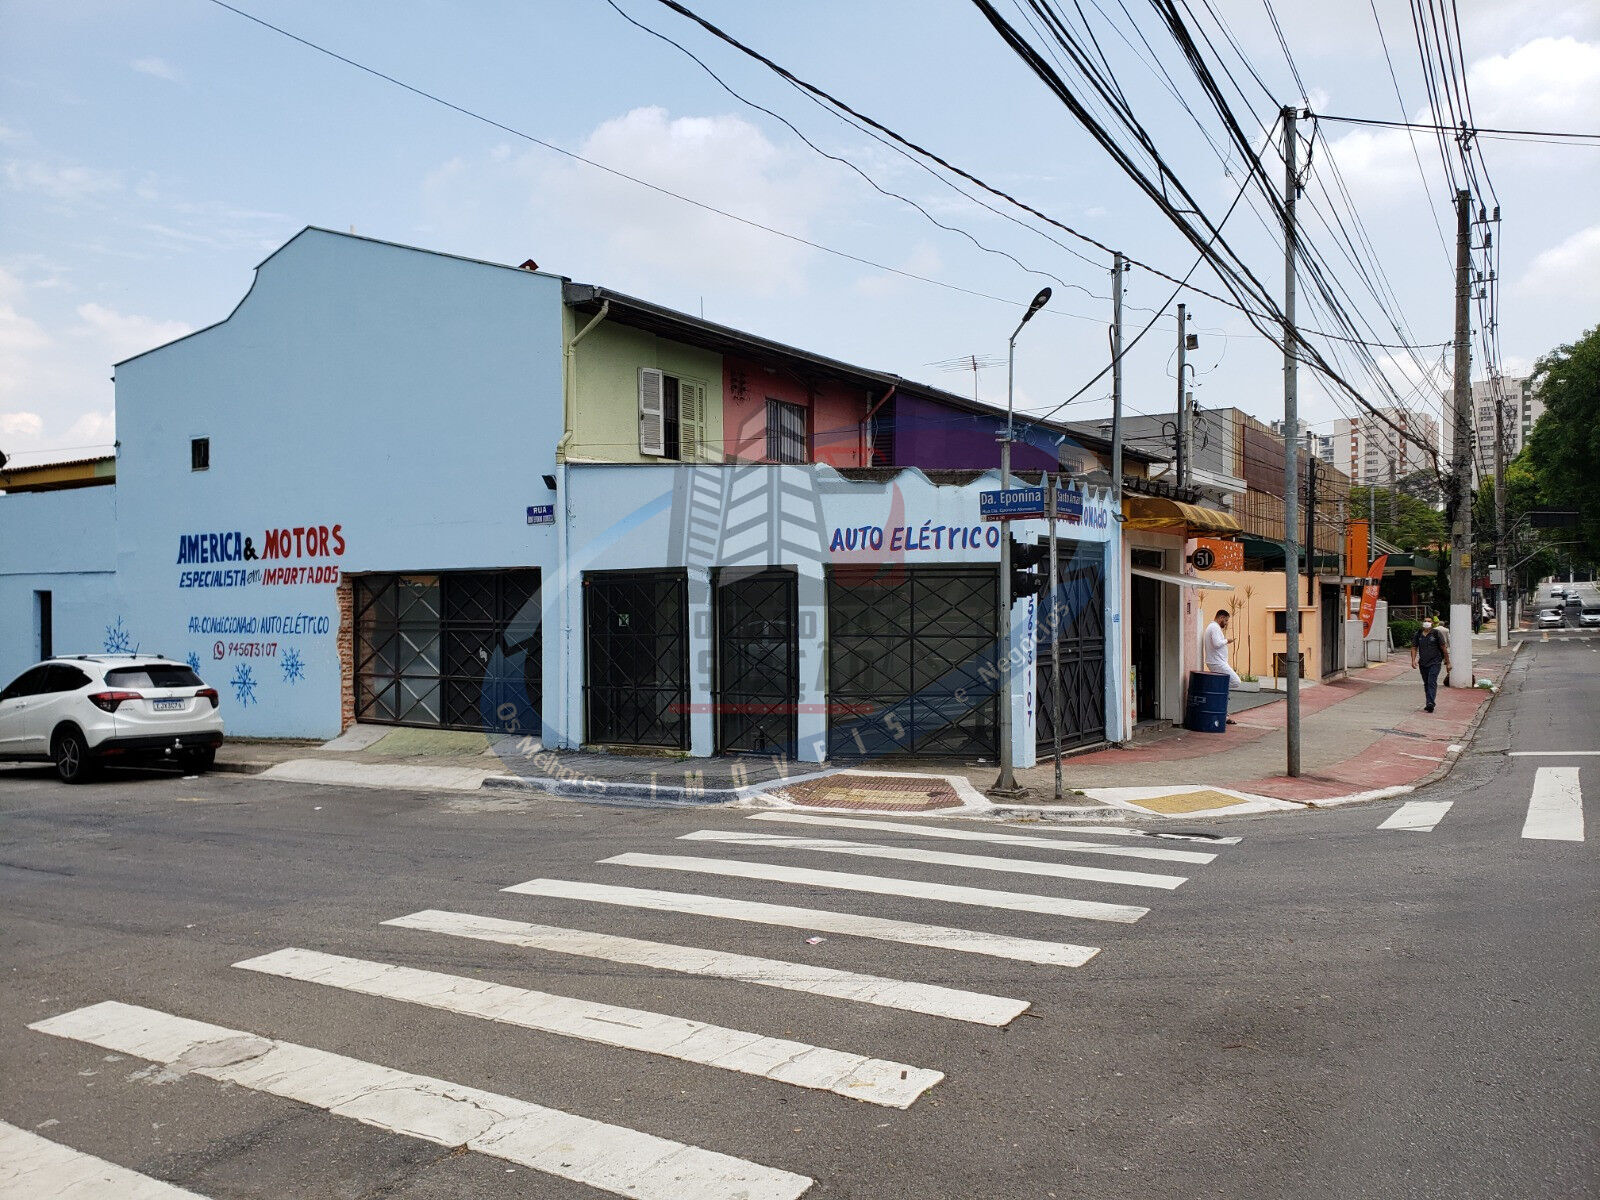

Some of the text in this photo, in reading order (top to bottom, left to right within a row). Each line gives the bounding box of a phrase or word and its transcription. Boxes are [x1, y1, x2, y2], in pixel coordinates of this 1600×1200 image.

[981, 490, 1041, 506] Da. Eponina
[533, 506, 547, 515] RUA
[176, 524, 345, 564] AMERICA & MOTORS
[829, 525, 883, 552] AUTO
[1196, 552, 1209, 566] 51
[178, 569, 246, 588] ESPECIALISTA
[262, 565, 339, 586] IMPORTADOS
[260, 616, 281, 633] AUTO
[228, 642, 277, 657] 945673107
[1027, 598, 1035, 729] 5673107
